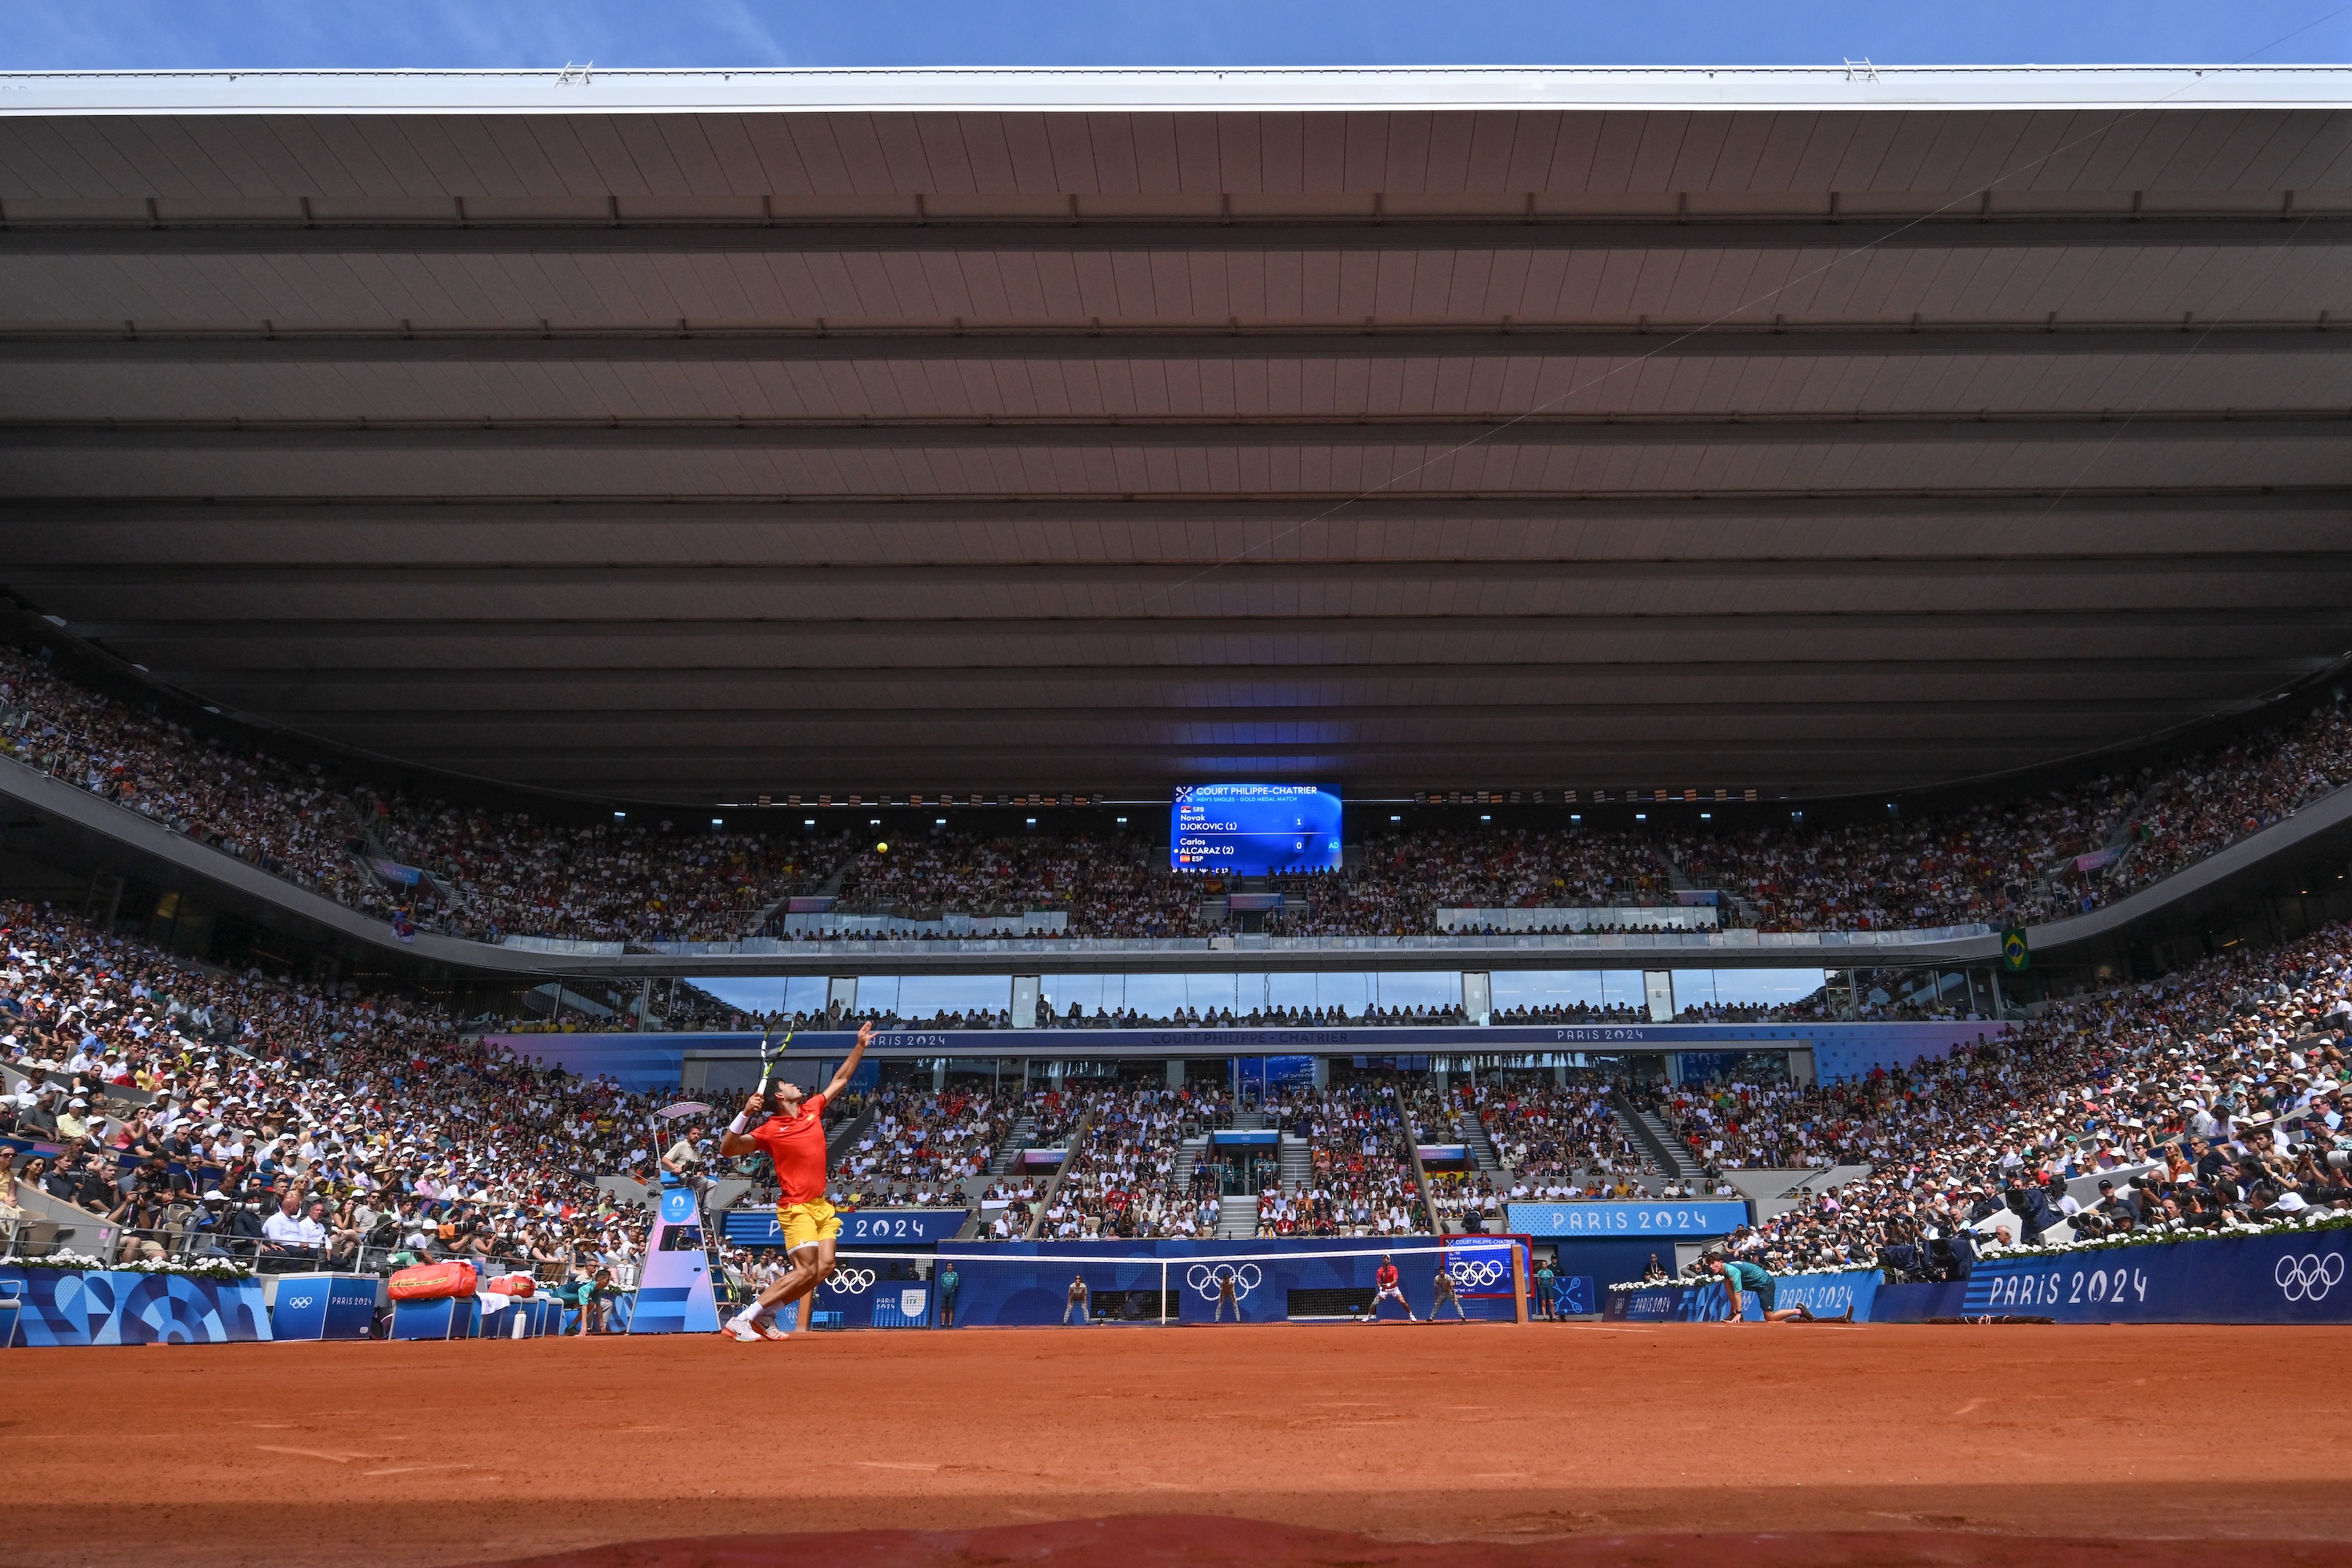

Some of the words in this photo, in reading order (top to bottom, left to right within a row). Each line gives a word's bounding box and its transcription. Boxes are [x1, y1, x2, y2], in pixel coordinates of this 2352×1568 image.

[1230, 786, 1317, 795] PHILIPPE-CHATRIER
[1225, 822, 1237, 831] (1)
[1222, 846, 1235, 855] (2)
[1152, 1033, 1200, 1044] COURT
[1204, 1033, 1265, 1044] PHILIPPE
[1279, 1033, 1348, 1043] CHATRIER
[1605, 1029, 1643, 1040] 2024
[907, 1036, 946, 1045] 2024
[1638, 1211, 1707, 1229] 2024
[855, 1220, 924, 1237] 2024
[2068, 1268, 2147, 1303] 2024
[354, 1297, 372, 1305] 2024
[1816, 1286, 1853, 1308] 2024
[1652, 1296, 1671, 1313] 2024
